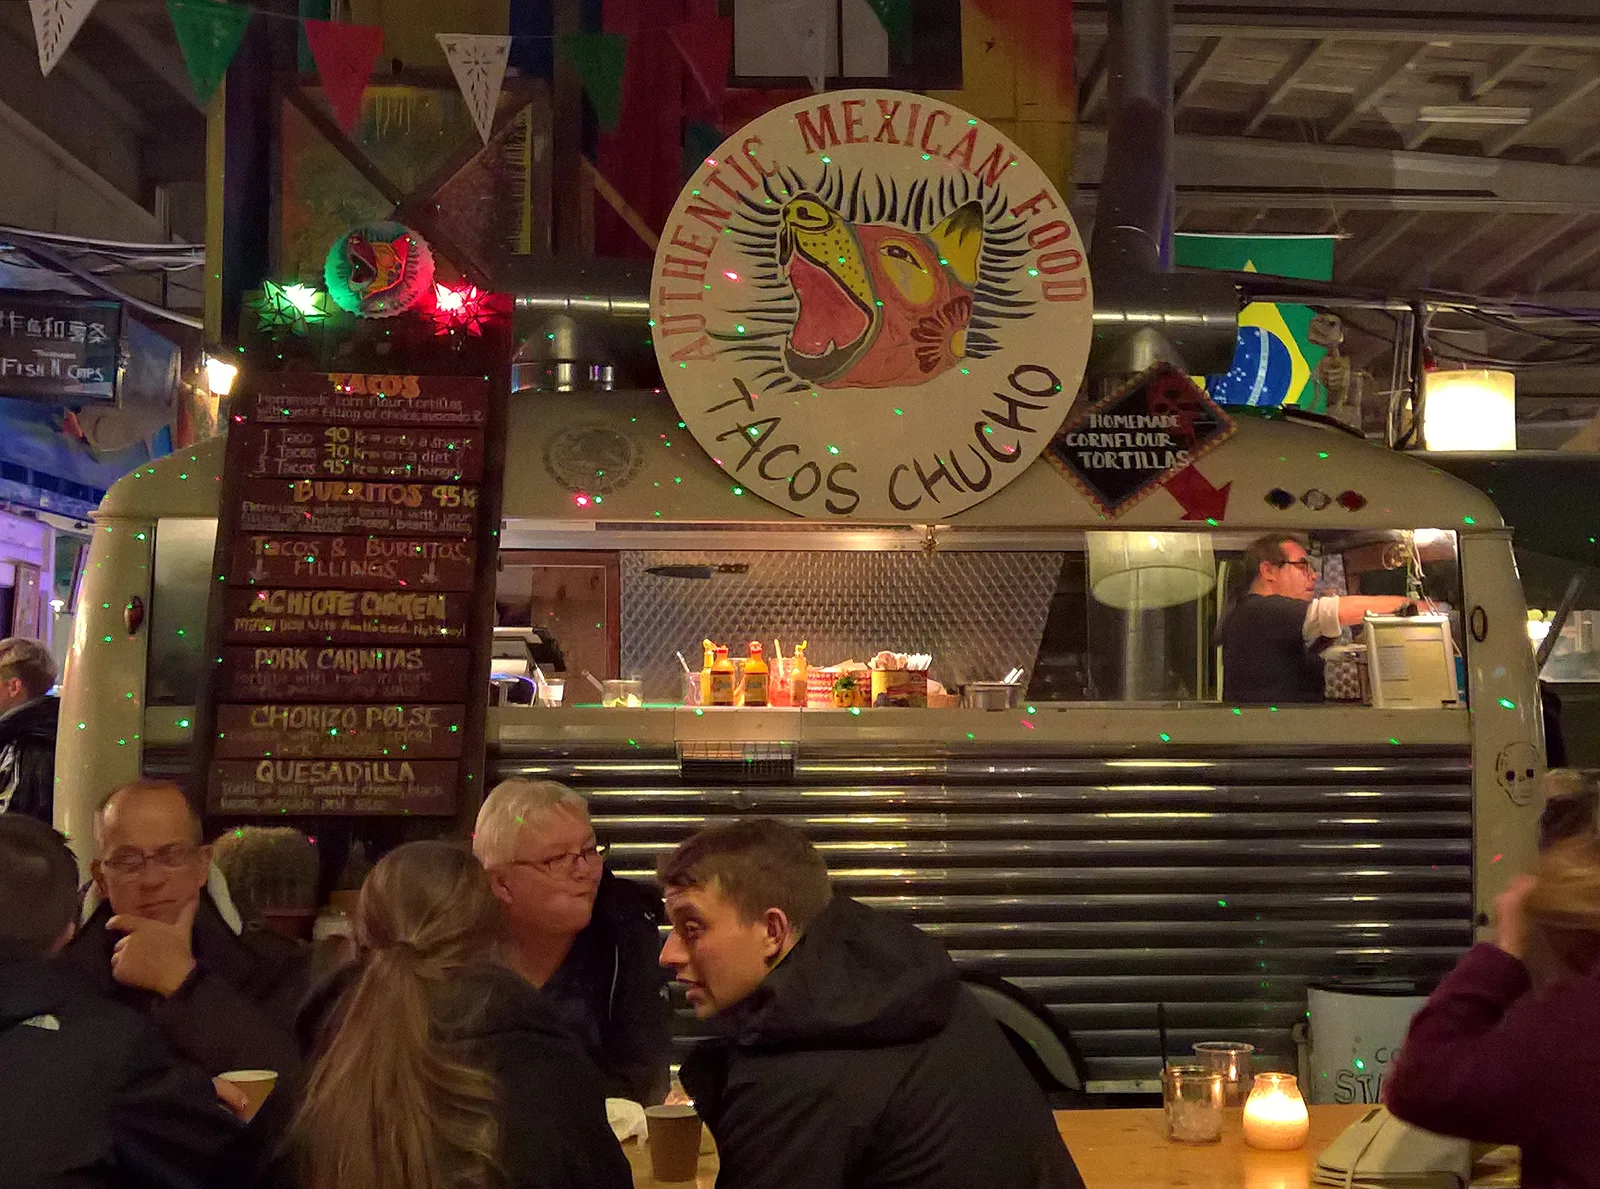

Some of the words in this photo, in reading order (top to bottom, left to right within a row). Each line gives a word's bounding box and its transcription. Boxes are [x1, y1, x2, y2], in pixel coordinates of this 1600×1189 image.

[658, 135, 780, 363] AUTHENTIC
[794, 99, 1018, 189] MEXICAN
[1010, 189, 1087, 303] FOOD
[328, 373, 421, 399] TACOS
[1088, 414, 1181, 429] HOMEMADE
[279, 429, 314, 444] Taco
[324, 427, 350, 443] 40
[702, 377, 861, 514] TACOS
[888, 363, 1062, 511] CHUCHO
[1065, 432, 1177, 448] CORNFLOUR
[324, 443, 350, 459] 70
[1078, 450, 1192, 470] TORTILLAS
[273, 458, 317, 475] Tacos
[323, 459, 346, 474] 95
[293, 480, 423, 507] BURRITOS
[331, 537, 347, 557] &
[366, 536, 471, 561] BURRITOS
[294, 558, 399, 579] FILLINGS
[249, 590, 356, 616] ACHIOTE
[255, 648, 308, 671] PORK
[316, 648, 424, 671] CARNITAS
[256, 760, 416, 784] QUESADILLA
